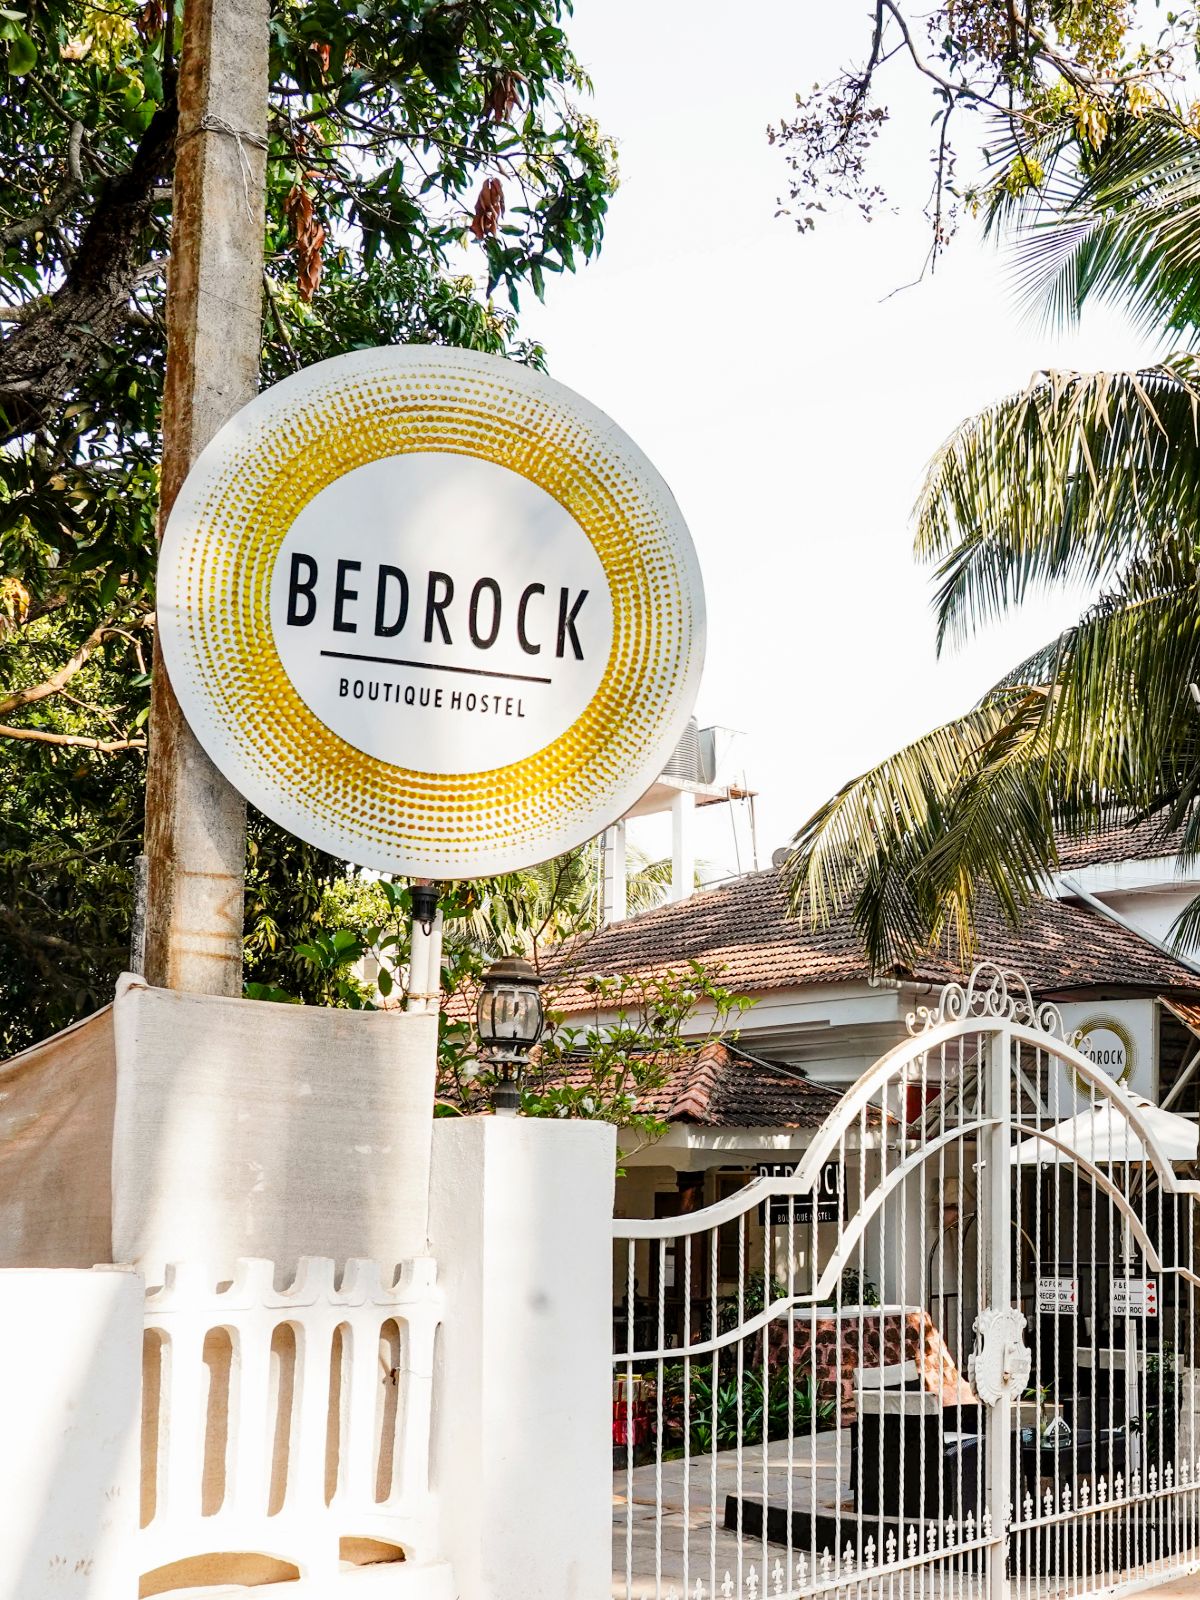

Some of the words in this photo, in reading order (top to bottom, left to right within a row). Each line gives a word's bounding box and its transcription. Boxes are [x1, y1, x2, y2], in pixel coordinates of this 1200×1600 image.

[286, 552, 590, 661] BEDROCK
[339, 678, 443, 709] BOUTIQUE
[450, 691, 526, 718] HOSTEL
[1078, 1050, 1123, 1065] DROCK
[809, 1211, 832, 1221] HSTEL
[1039, 1292, 1068, 1300] RECEPON
[1130, 1306, 1143, 1314] ROC
